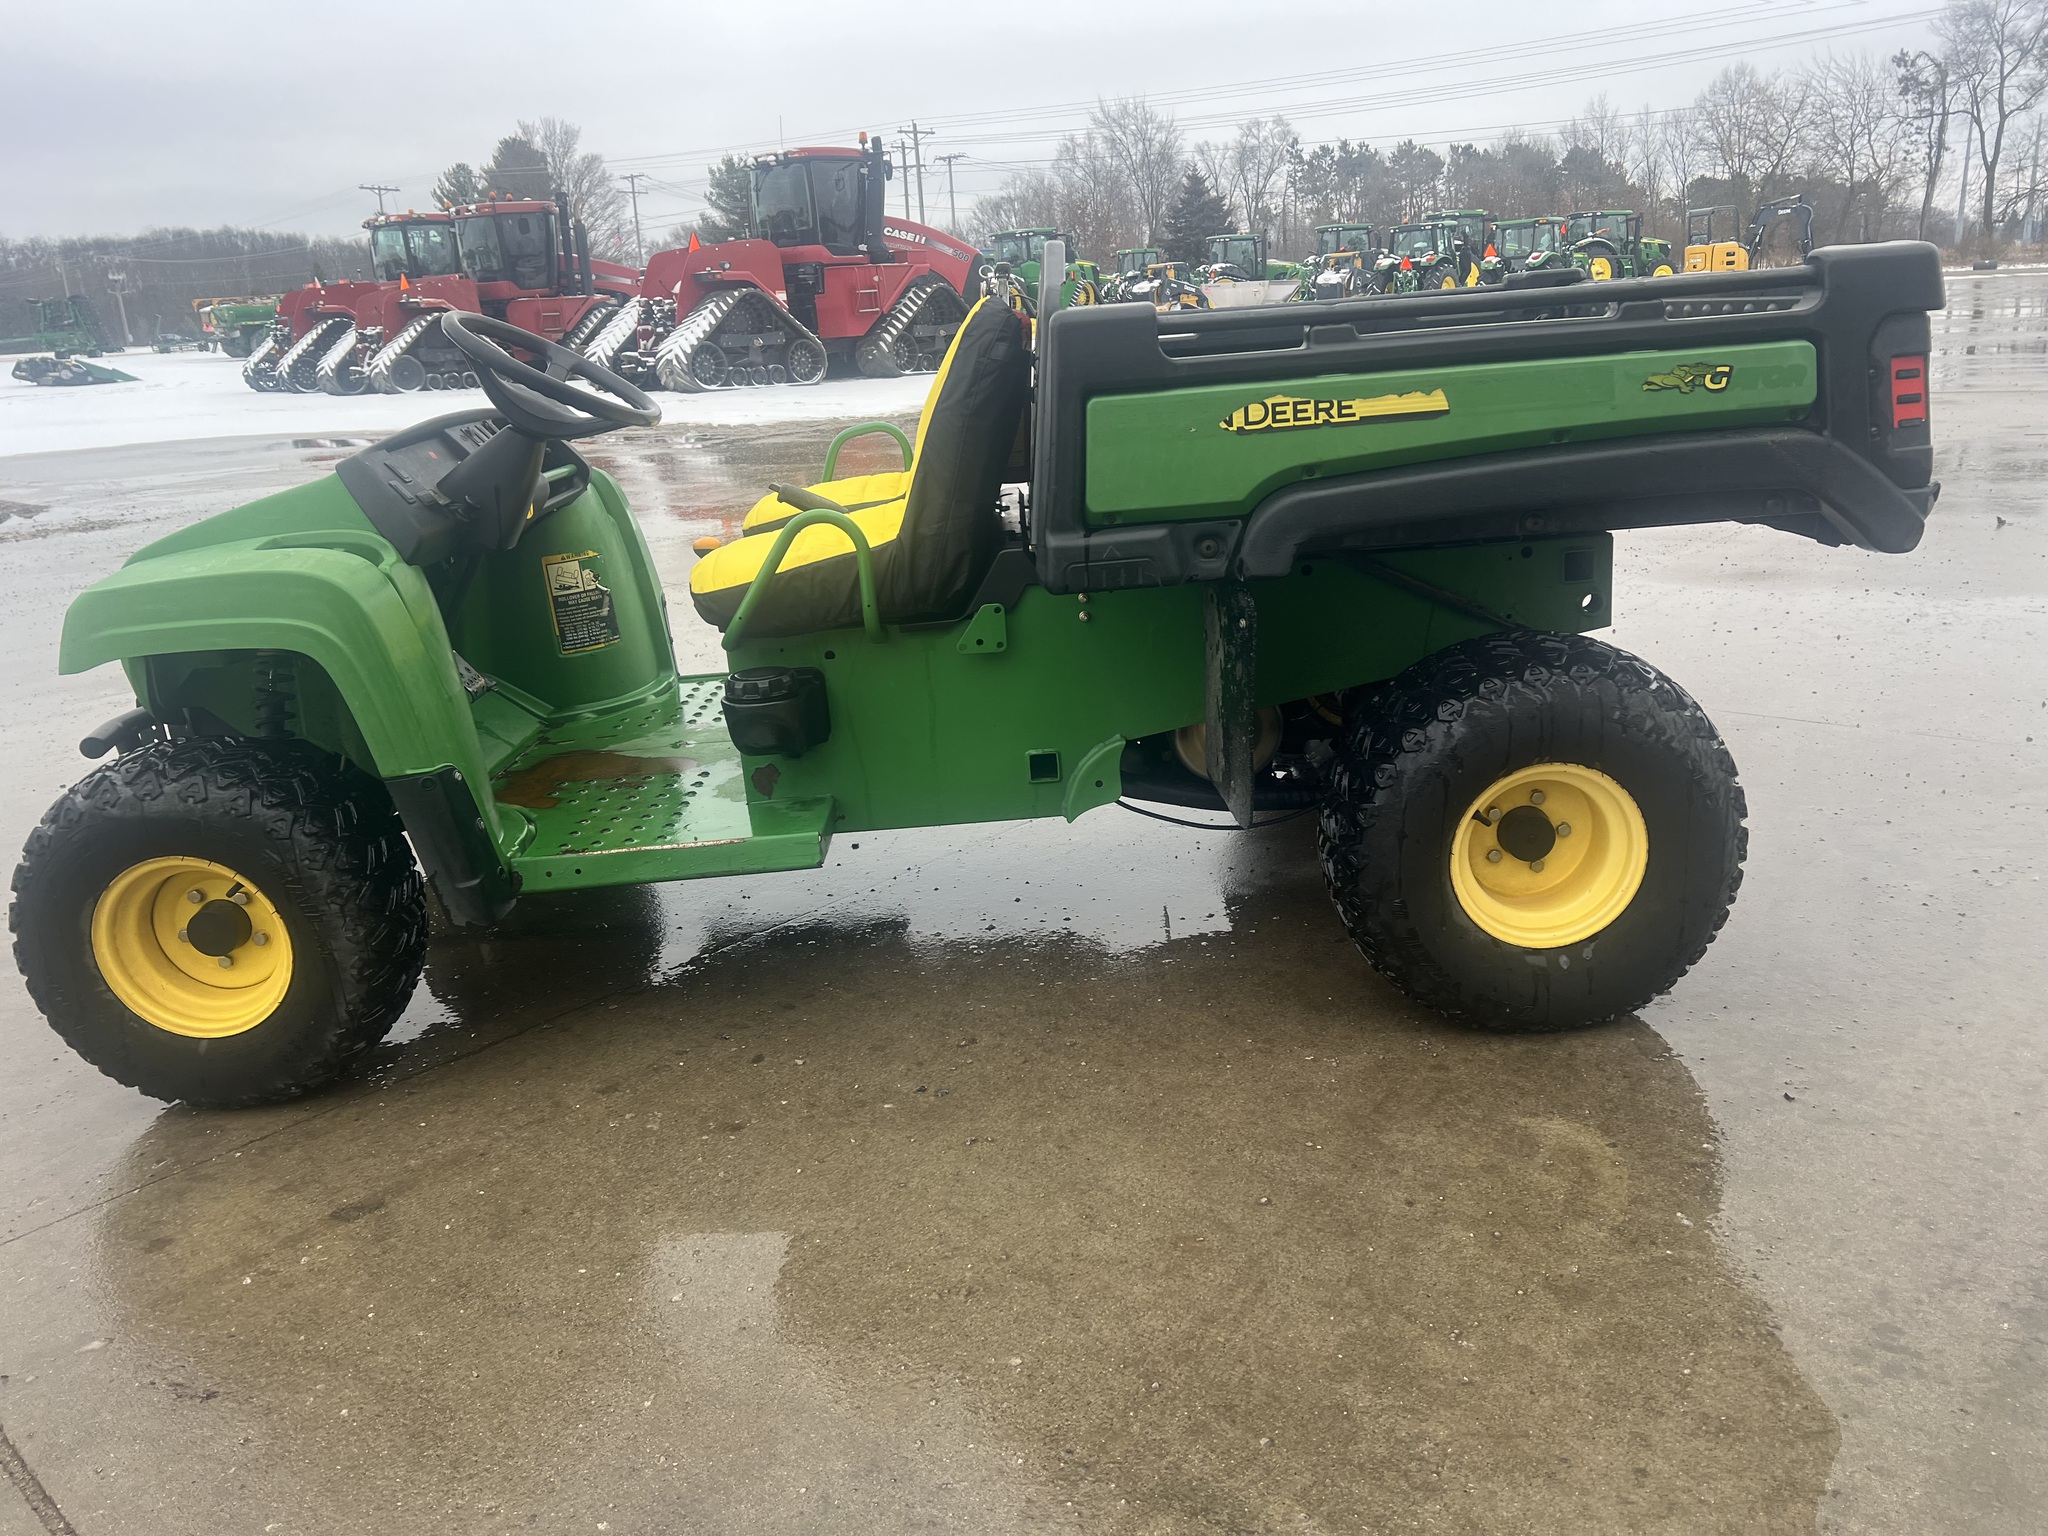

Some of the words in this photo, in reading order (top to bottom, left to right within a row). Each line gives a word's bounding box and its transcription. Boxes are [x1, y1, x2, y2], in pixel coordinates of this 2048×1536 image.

[883, 227, 914, 241] CASE
[953, 249, 970, 263] 500
[1244, 400, 1357, 427] DEERE
